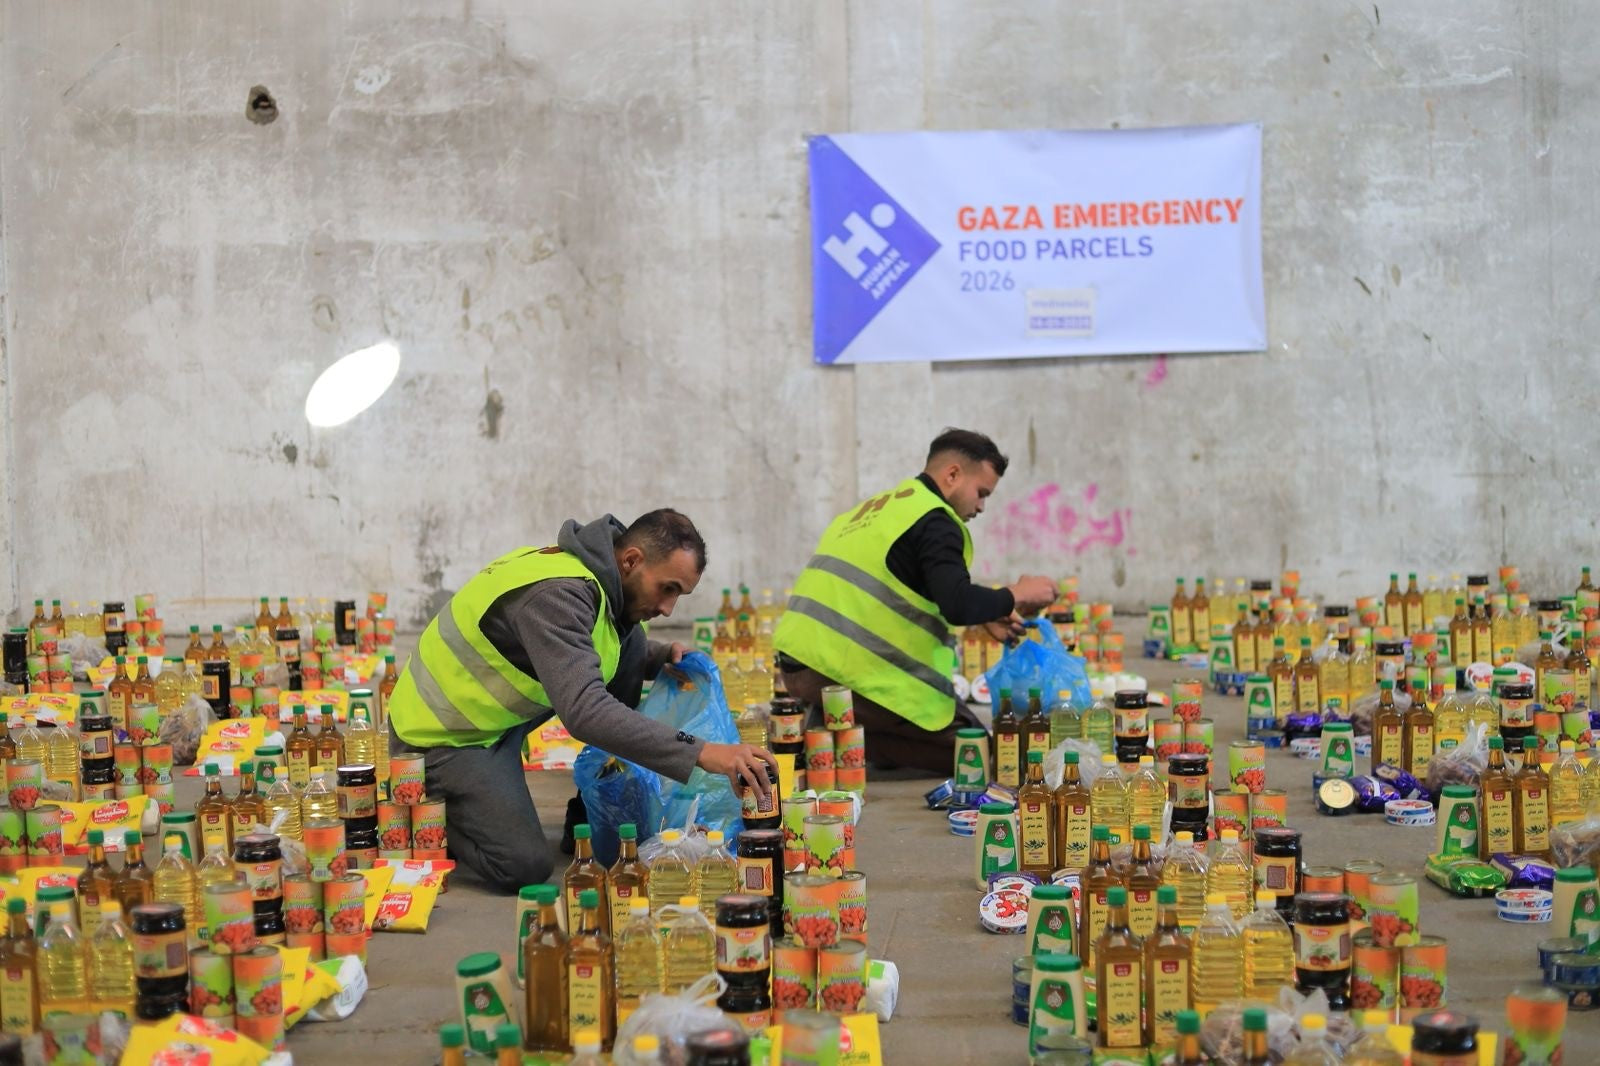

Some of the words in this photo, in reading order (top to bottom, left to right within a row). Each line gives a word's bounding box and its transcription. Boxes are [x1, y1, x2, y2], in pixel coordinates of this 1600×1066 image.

[957, 205, 1043, 231] GAZA
[1053, 198, 1244, 228] EMERGENCY
[959, 241, 1026, 261] FOOD
[1036, 236, 1154, 259] PARCELS
[860, 248, 901, 291] HUMAN
[870, 260, 911, 300] APPEAL
[960, 271, 1015, 292] 2026
